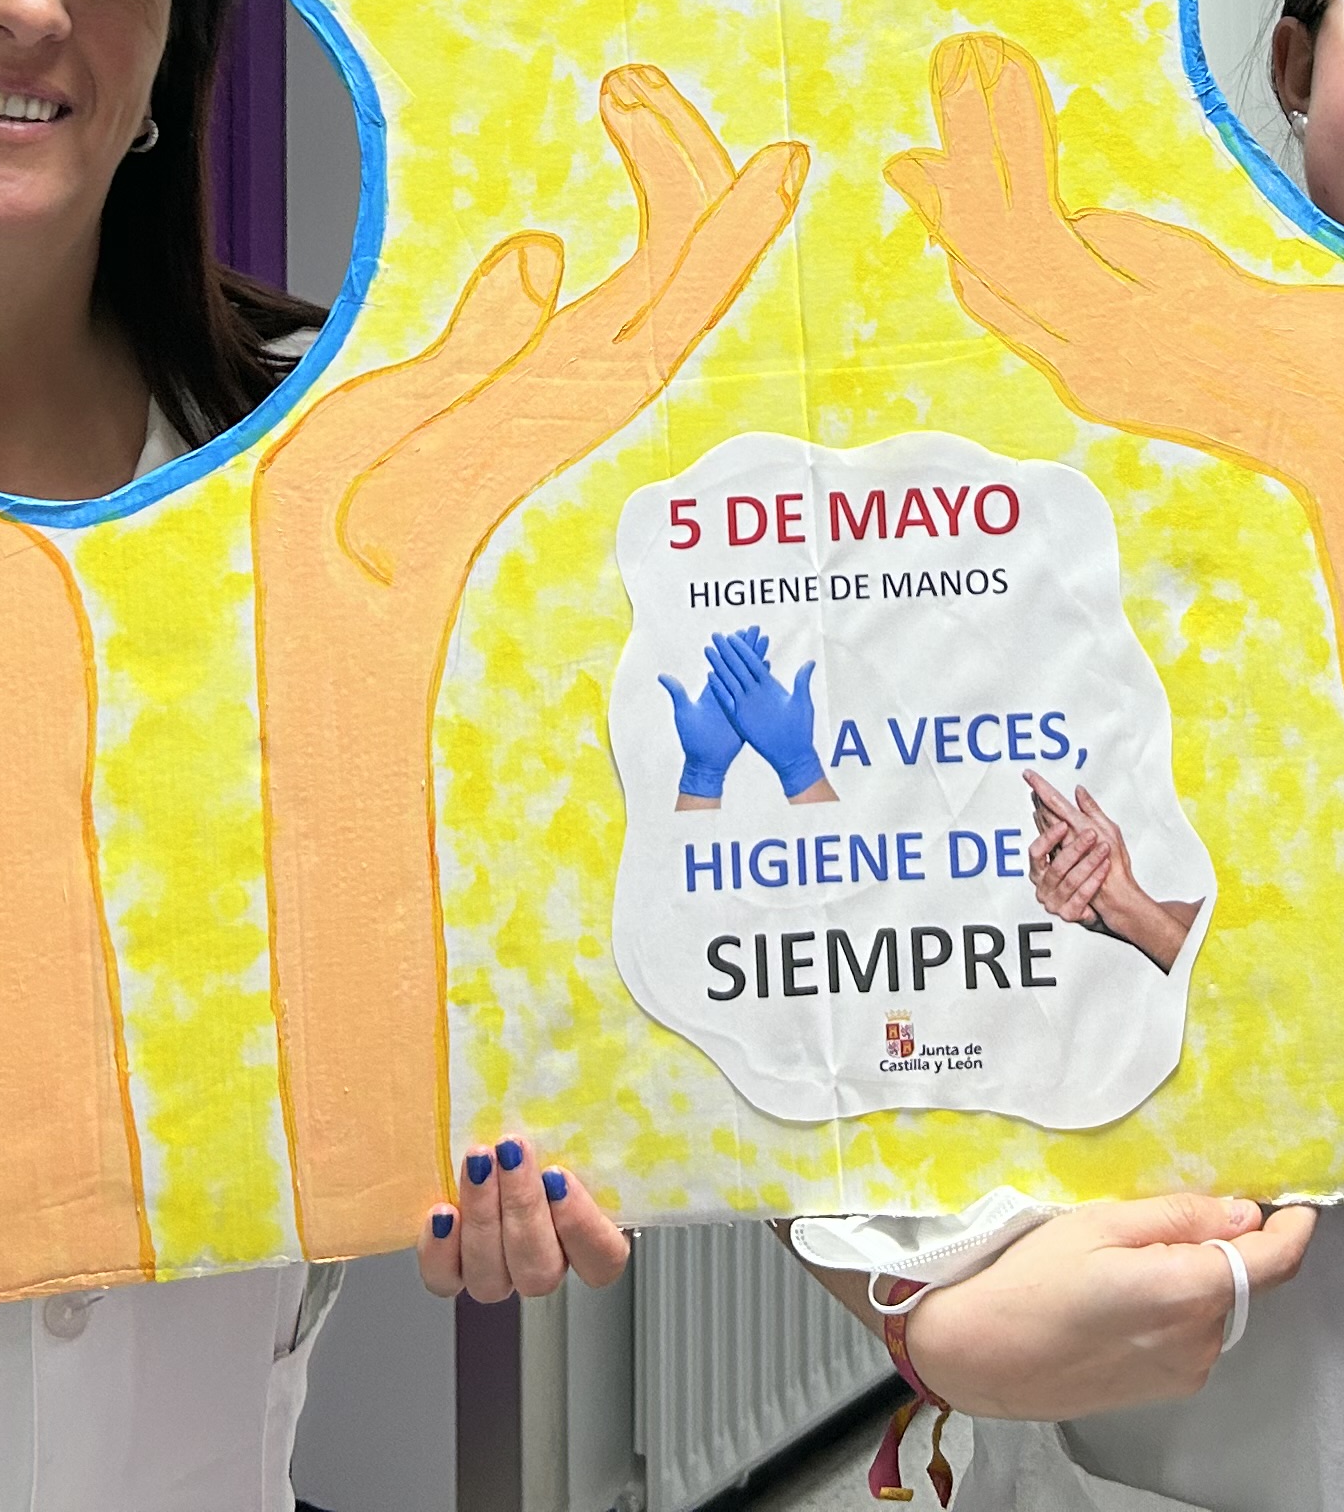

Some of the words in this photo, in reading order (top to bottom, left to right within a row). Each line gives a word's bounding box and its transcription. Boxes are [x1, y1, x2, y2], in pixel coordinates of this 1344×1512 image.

[668, 498, 702, 551] 5
[725, 492, 807, 548] DE
[828, 483, 1021, 543] MAYO
[689, 575, 820, 609] HIGIENE
[829, 573, 871, 602] DE
[881, 567, 1010, 600] MANOS
[829, 718, 872, 769] A
[886, 710, 1089, 771] VECES,
[684, 831, 927, 893] HIGIENE
[947, 828, 1026, 880] DE
[705, 921, 1058, 1003] SIEMPRE
[879, 1058, 930, 1072] Castilla
[934, 1060, 943, 1074] y
[947, 1056, 984, 1070] León
[919, 1043, 960, 1056] Junta
[964, 1042, 983, 1055] de
